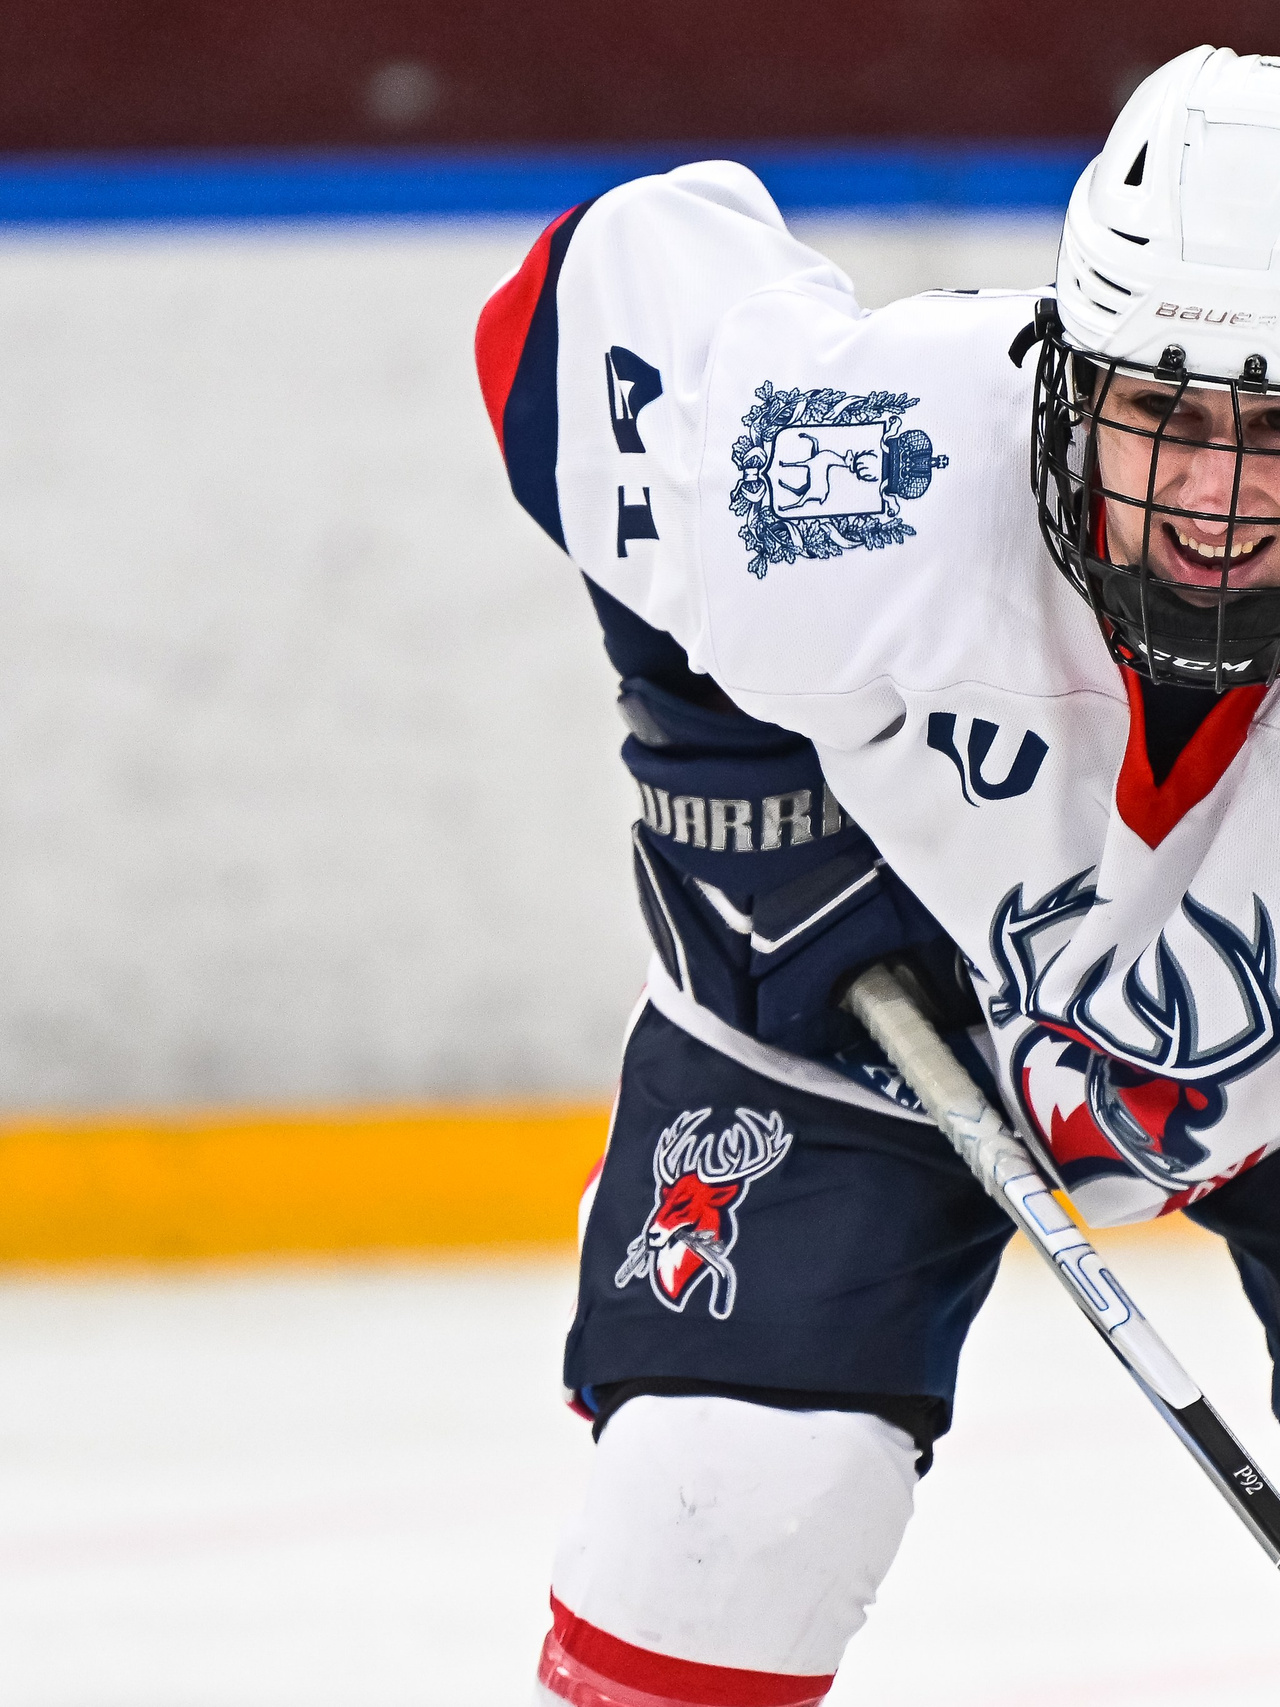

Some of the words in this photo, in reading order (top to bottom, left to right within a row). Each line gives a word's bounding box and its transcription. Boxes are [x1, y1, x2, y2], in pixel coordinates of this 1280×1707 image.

[1138, 640, 1253, 672] CCM
[638, 780, 856, 852] WARRI
[1233, 1464, 1264, 1496] P92
